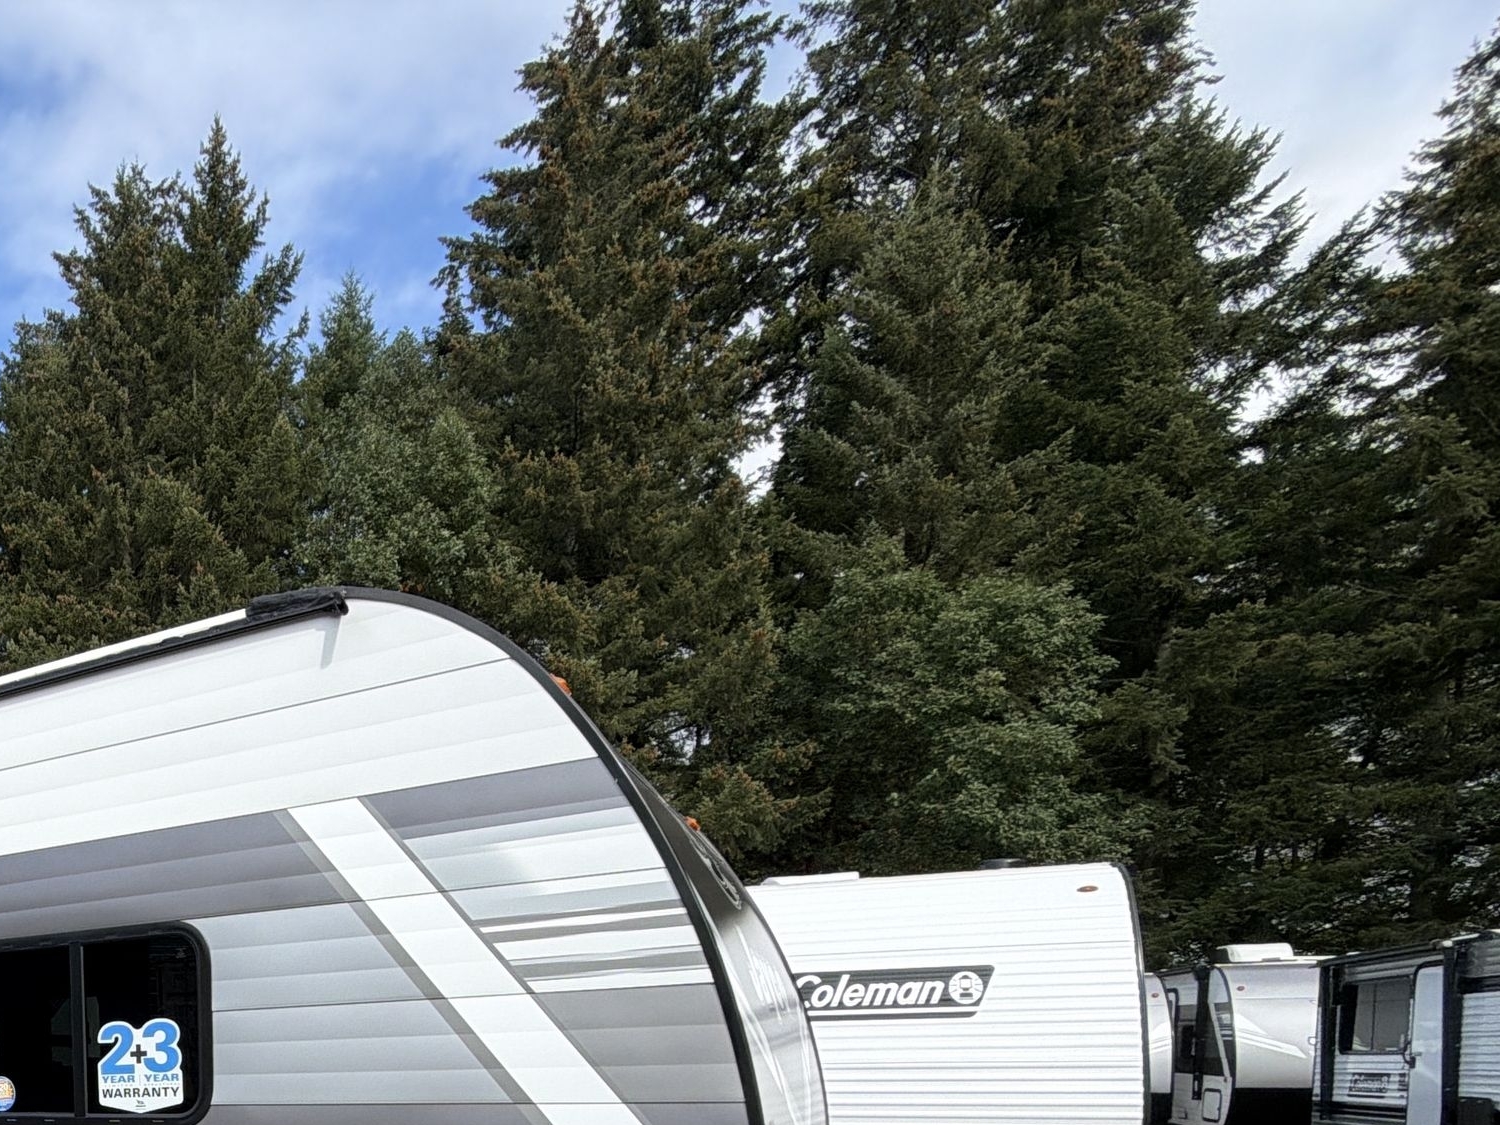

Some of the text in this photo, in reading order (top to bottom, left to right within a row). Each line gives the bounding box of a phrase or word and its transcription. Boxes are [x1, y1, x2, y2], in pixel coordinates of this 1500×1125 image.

[102, 1073, 180, 1084] YEAR YEAR
[102, 1087, 180, 1098] WARRANTY
